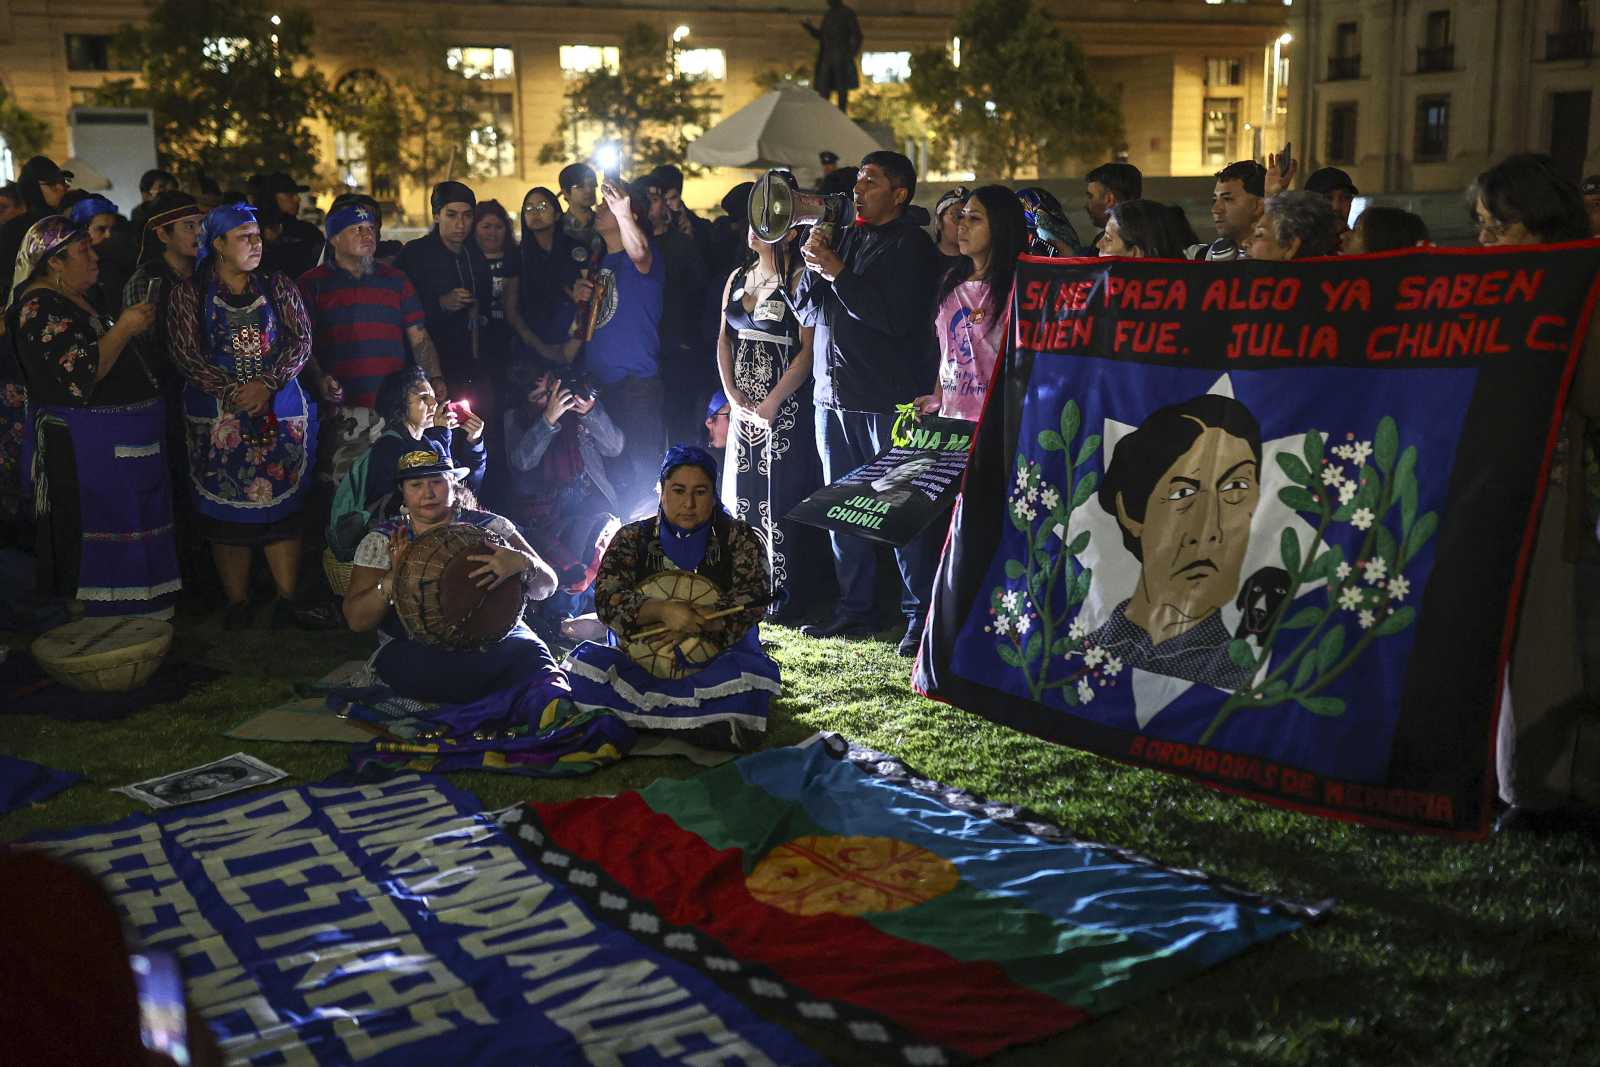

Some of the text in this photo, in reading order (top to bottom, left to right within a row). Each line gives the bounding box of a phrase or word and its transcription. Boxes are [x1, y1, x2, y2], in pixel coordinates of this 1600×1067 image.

[1022, 280, 1049, 311] SI
[1104, 275, 1187, 312] PASA
[1201, 275, 1302, 313] ALGO
[1320, 276, 1373, 313] YA
[1394, 268, 1546, 312] SABEN
[1113, 319, 1191, 354] FUE.
[1225, 322, 1339, 360] JULIA
[1365, 311, 1511, 362] CHUÑIL
[826, 504, 884, 530] CHUÑIL
[844, 495, 892, 515] JULIA
